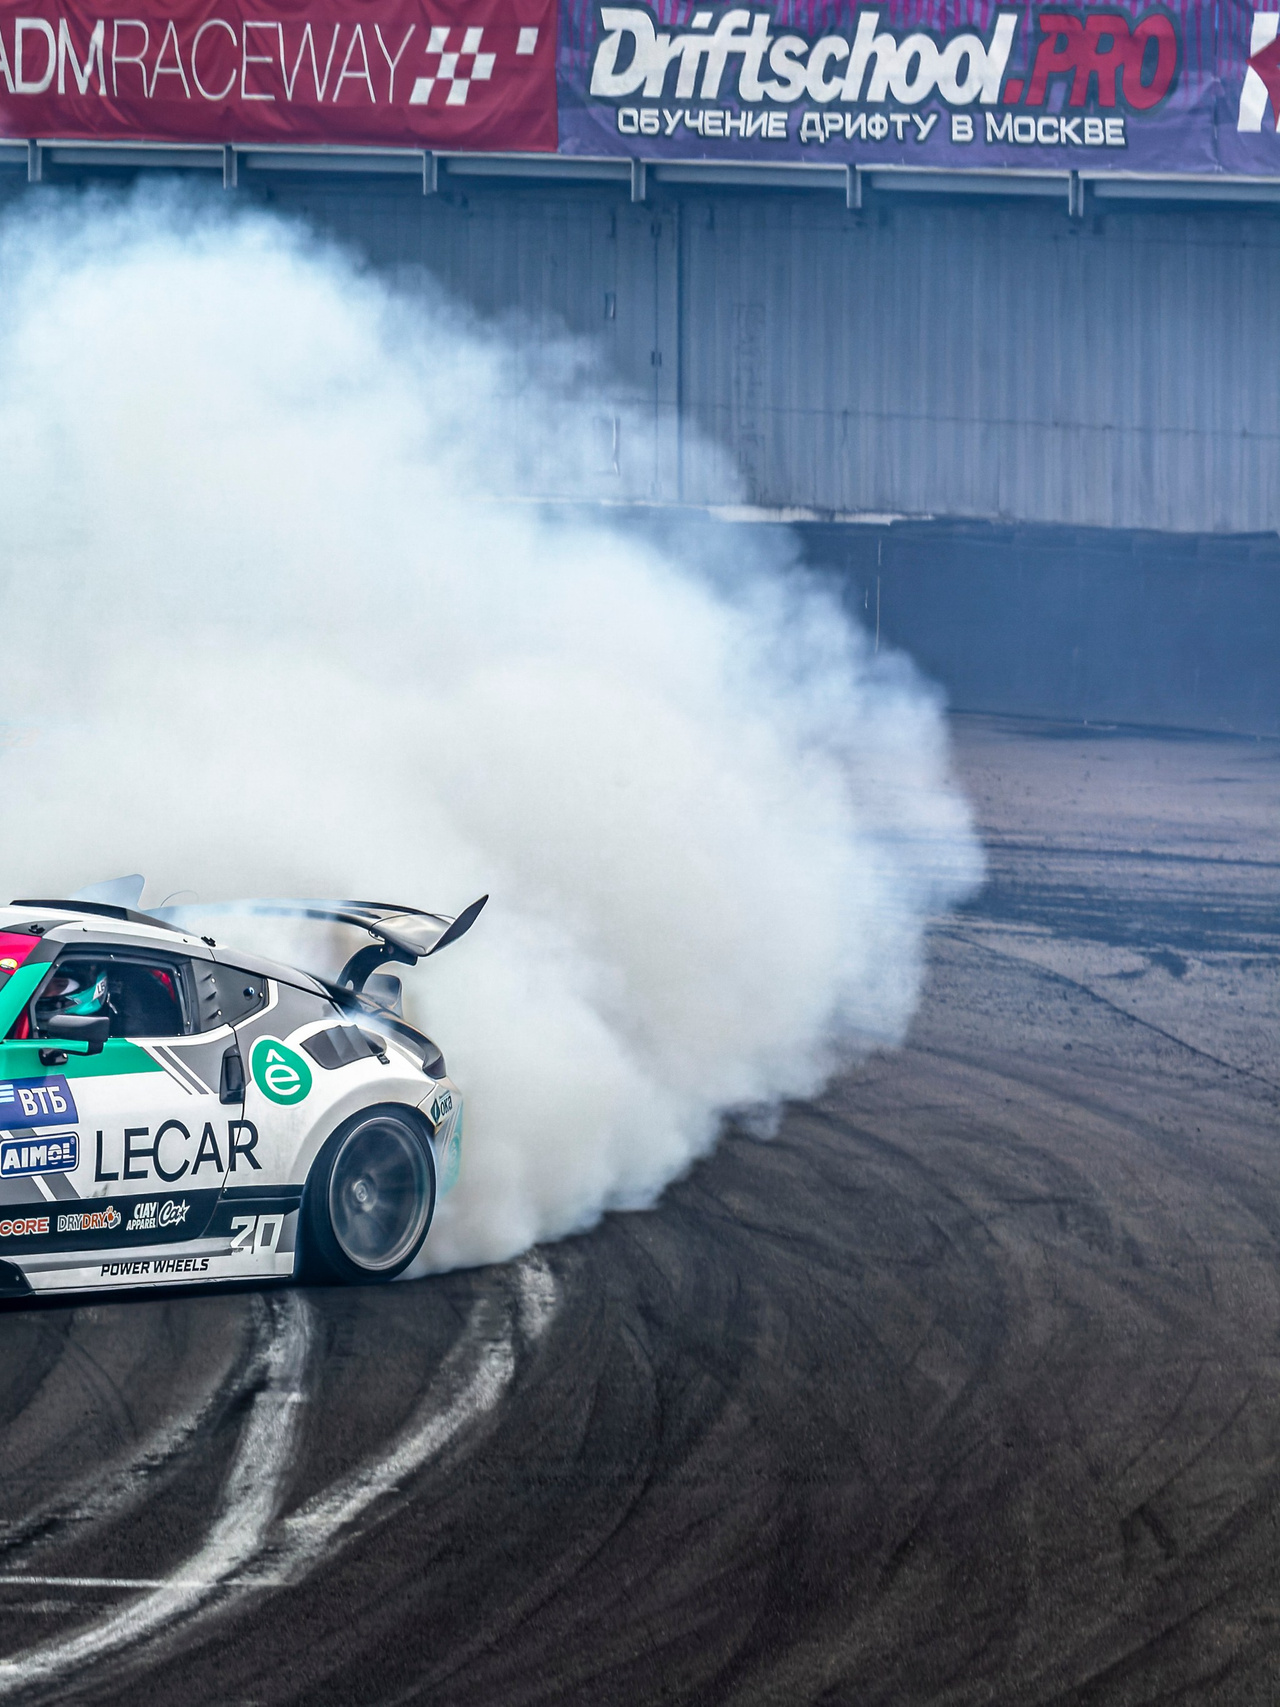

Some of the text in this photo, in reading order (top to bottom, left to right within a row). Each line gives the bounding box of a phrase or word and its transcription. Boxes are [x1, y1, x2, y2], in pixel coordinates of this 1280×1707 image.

[618, 107, 788, 139] ОБУЧЕНИЕ
[800, 112, 937, 143] ДРИФТУ
[951, 114, 974, 142] В
[17, 1085, 68, 1117] ВТБ
[94, 1119, 263, 1183] LECAR
[126, 1217, 156, 1231] APPAREL
[230, 1213, 285, 1255] 20
[101, 1259, 209, 1276] POWER WHEELS
